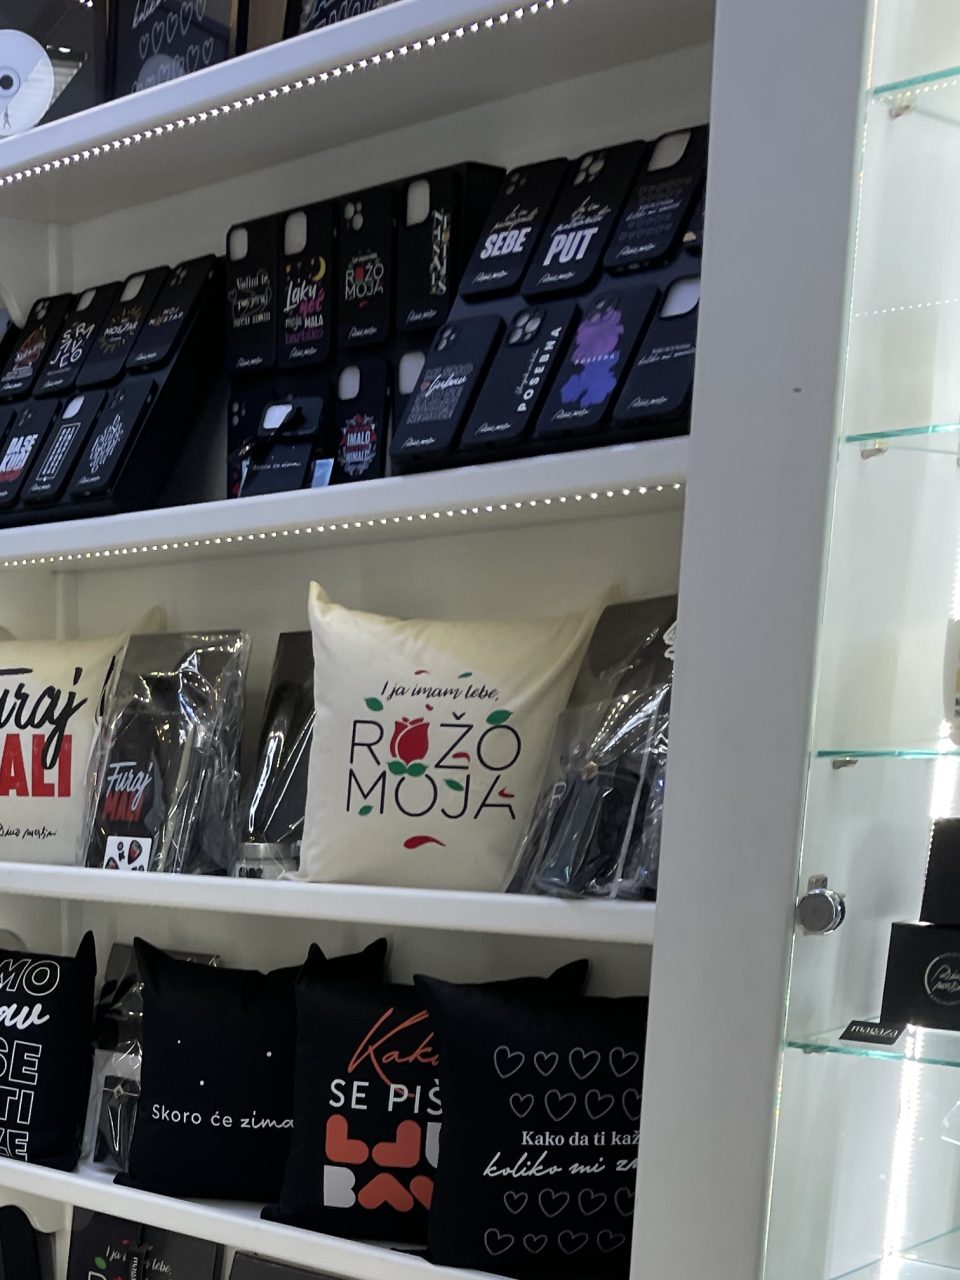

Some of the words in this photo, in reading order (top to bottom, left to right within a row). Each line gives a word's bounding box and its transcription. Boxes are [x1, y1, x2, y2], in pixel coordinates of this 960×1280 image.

[480, 226, 532, 260] SEBE
[542, 226, 599, 267] PUT
[517, 326, 562, 413] POSEBNA
[347, 431, 371, 447] IMALO
[386, 683, 410, 701] ja
[410, 683, 464, 700] imam
[105, 760, 154, 812] Furaj
[346, 769, 517, 821] MOJA
[329, 1078, 370, 1110] SE
[387, 1078, 443, 1116] PIŠ
[151, 1103, 203, 1126] Skoro
[210, 1108, 234, 1129] će
[240, 1111, 295, 1130] zima
[521, 1130, 565, 1146] Kako
[568, 1131, 589, 1146] da
[593, 1131, 606, 1146] ti
[610, 1129, 641, 1146] kaž
[483, 1150, 563, 1178] koliko
[568, 1156, 606, 1175] mi
